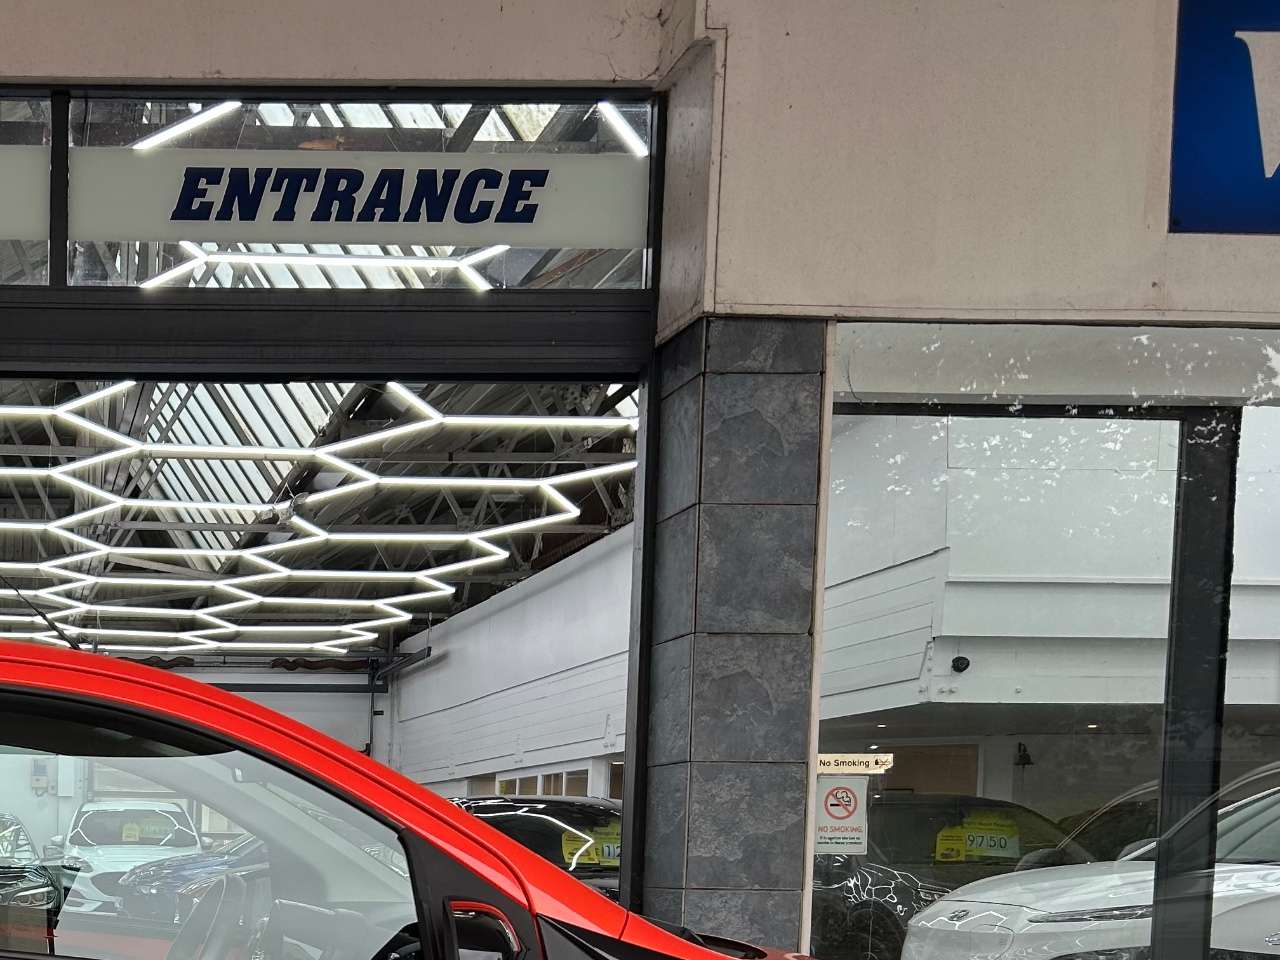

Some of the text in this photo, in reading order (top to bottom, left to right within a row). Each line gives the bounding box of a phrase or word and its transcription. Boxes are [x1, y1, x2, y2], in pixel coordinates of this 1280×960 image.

[170, 167, 550, 224] ENTRANCE
[819, 759, 870, 768] No Smoking
[818, 825, 829, 833] NO
[967, 834, 1008, 849] 9750
